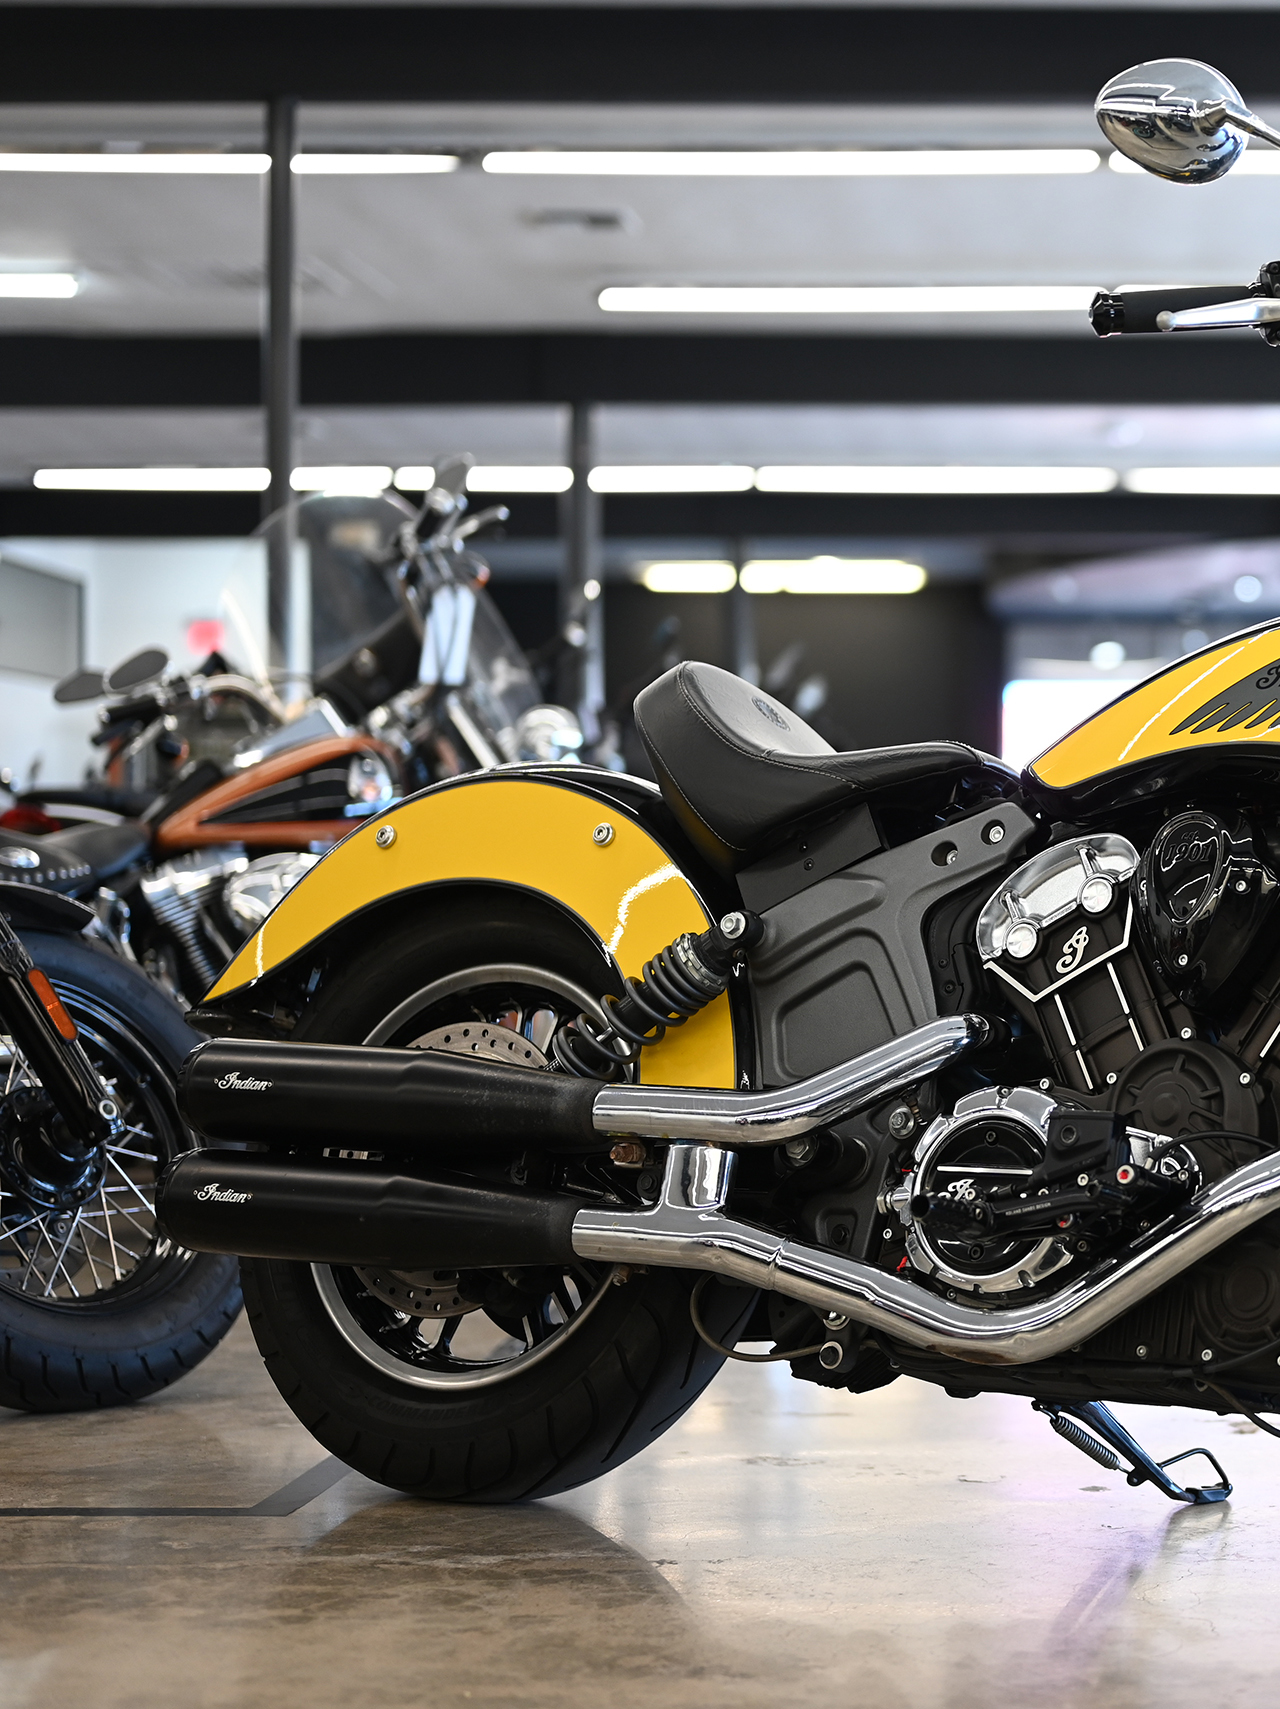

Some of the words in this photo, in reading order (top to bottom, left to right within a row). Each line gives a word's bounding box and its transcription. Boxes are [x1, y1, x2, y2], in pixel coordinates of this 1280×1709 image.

[1165, 841, 1212, 862] 1901
[218, 1071, 268, 1091] Indian
[197, 1183, 247, 1204] Indian
